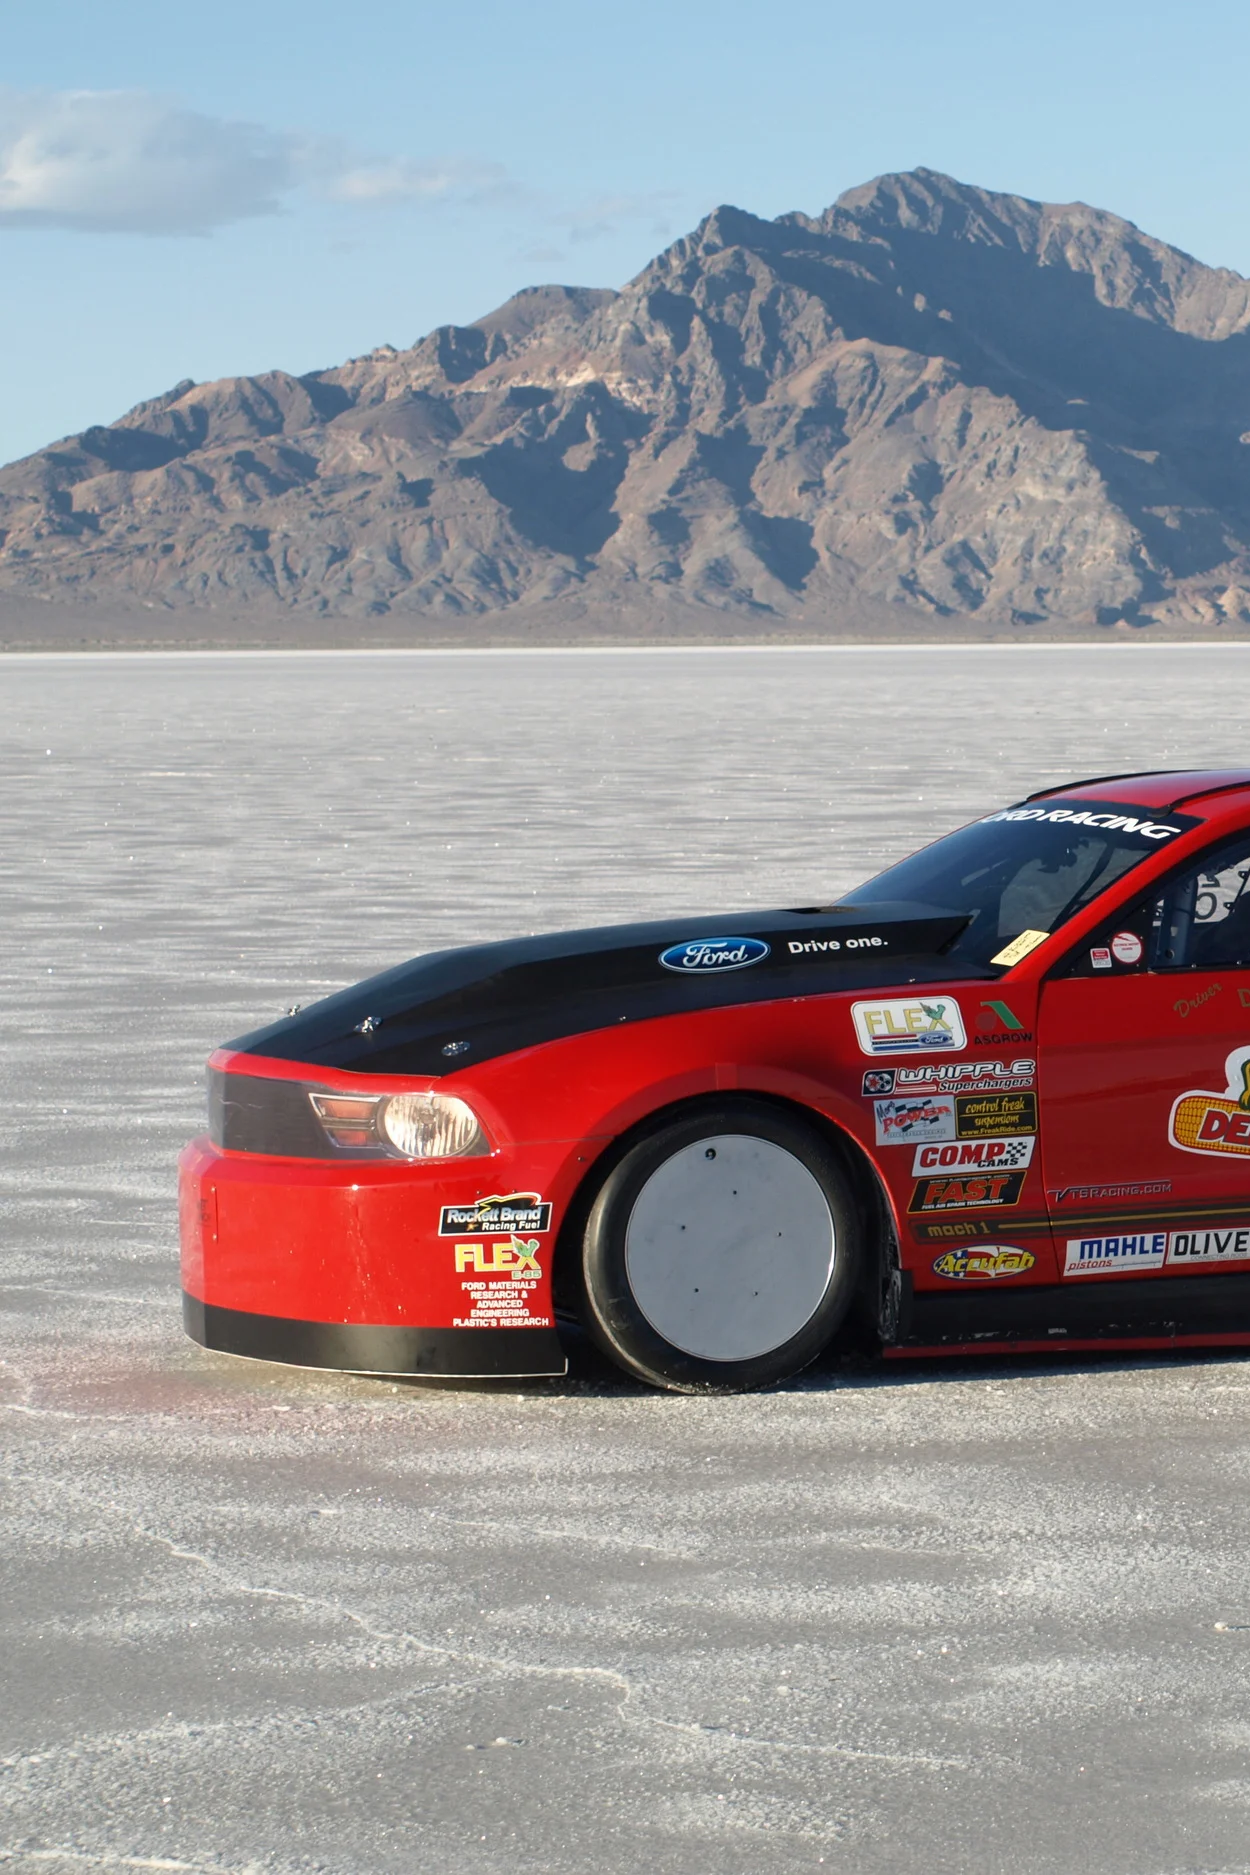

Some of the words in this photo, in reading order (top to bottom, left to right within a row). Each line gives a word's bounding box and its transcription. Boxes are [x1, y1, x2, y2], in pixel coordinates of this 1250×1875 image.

[980, 809, 1046, 823] ORD
[1036, 809, 1182, 840] RACING
[788, 940, 841, 954] Drive
[845, 936, 889, 949] one.
[682, 942, 749, 967] Ford
[1173, 982, 1222, 1018] Driver
[863, 1003, 954, 1035] FLEX
[974, 1032, 1033, 1046] ASGROW
[898, 1059, 1036, 1083] WHIPPLE
[938, 1077, 1033, 1093] Superchargers
[965, 1100, 1000, 1115] control
[1001, 1096, 1025, 1113] freak
[882, 1105, 952, 1134] POWER
[974, 1112, 1020, 1126] suspensions
[961, 1125, 1033, 1136] www.FreakRide.com
[919, 1142, 1006, 1169] COMP
[977, 1157, 1020, 1168] CAMS
[923, 1178, 1009, 1205] FAST
[447, 1208, 501, 1223] Rockett
[500, 1206, 544, 1221] Brand
[481, 1221, 517, 1232] Racing
[518, 1219, 541, 1230] Fuel
[927, 1222, 977, 1237] mach
[979, 1221, 991, 1234] 1
[1080, 1234, 1165, 1260] MAHLE
[454, 1239, 542, 1273] FLEX
[937, 1252, 1035, 1273] Accufab
[1067, 1259, 1113, 1272] pistons
[511, 1269, 542, 1280] E-85
[461, 1281, 486, 1290] FORD
[488, 1280, 537, 1290] MATERIALS
[470, 1290, 518, 1300] RESEARCH
[521, 1290, 528, 1299] &
[476, 1299, 524, 1309] ADVANCED
[470, 1308, 530, 1318] ENGINEERING
[452, 1318, 498, 1327] PLASTIC'S
[499, 1317, 549, 1327] RESEARCH
